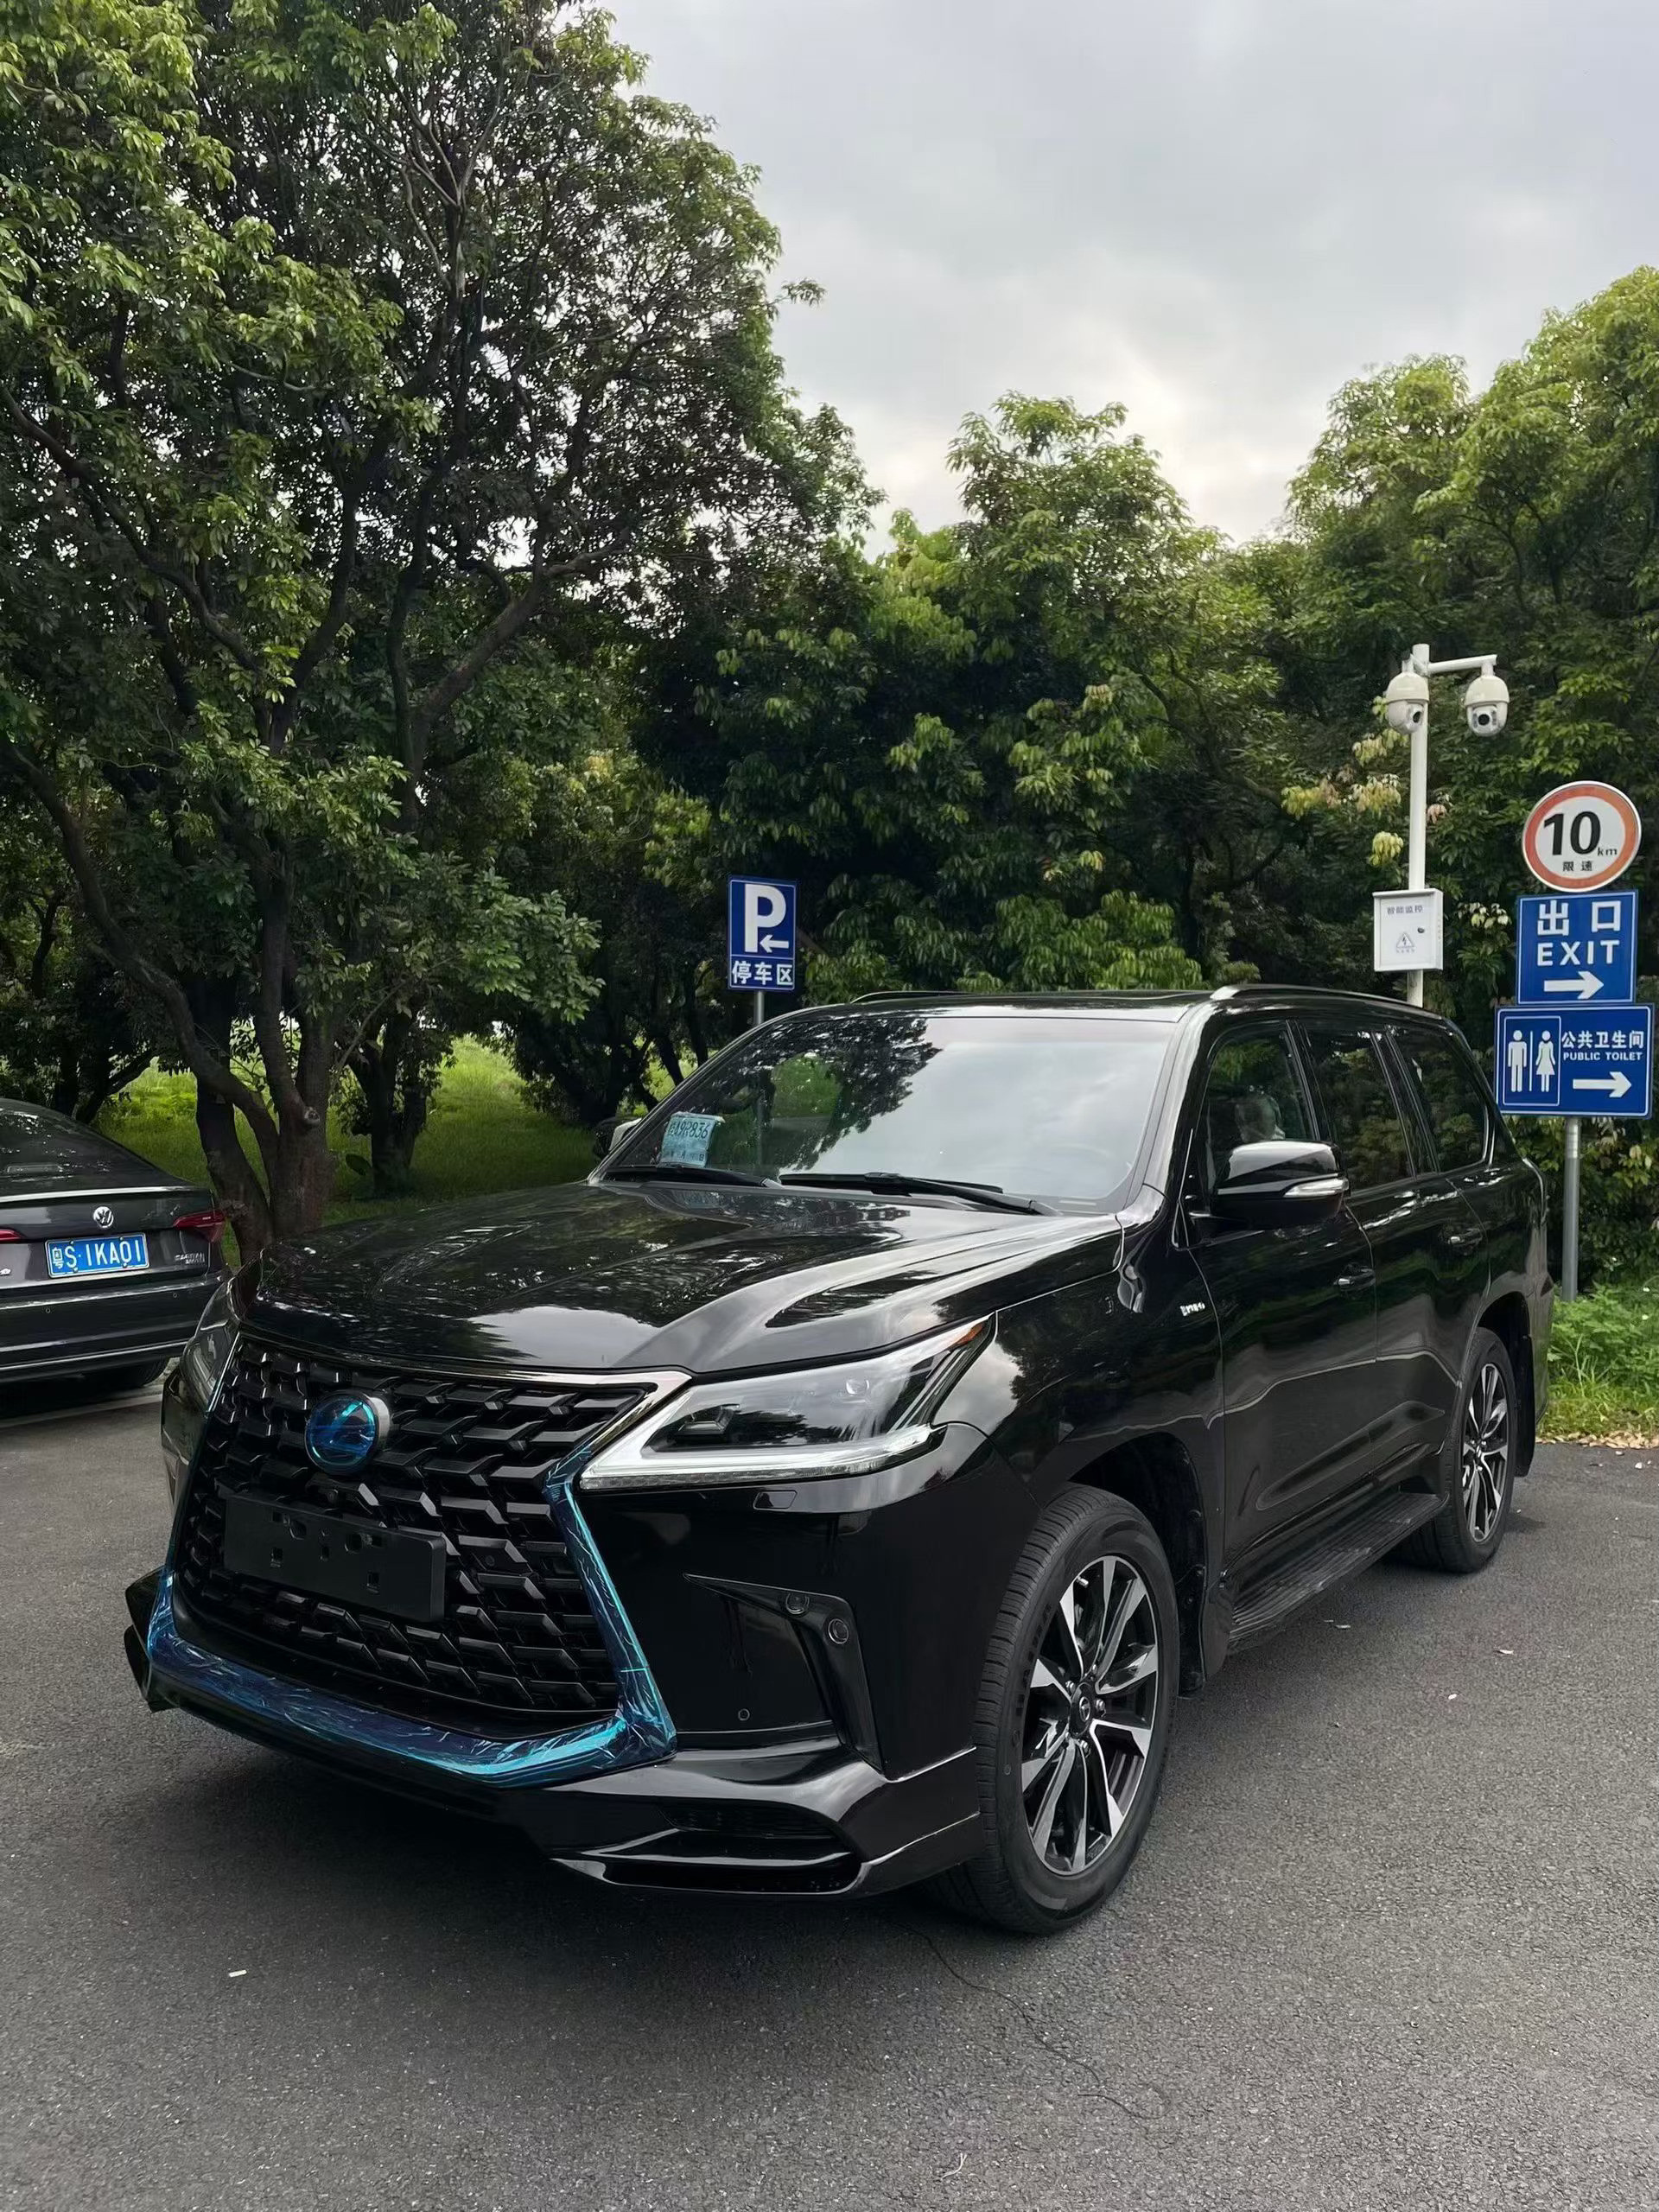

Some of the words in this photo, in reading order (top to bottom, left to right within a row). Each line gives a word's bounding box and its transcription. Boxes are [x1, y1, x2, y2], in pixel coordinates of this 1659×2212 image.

[1544, 810, 1601, 855] 10
[1597, 847, 1618, 856] km
[1562, 860, 1592, 872] 限速
[744, 883, 787, 953] P
[1537, 899, 1621, 936] 出口
[1537, 939, 1620, 966] EXIT
[732, 960, 793, 985] 停车区
[1561, 1030, 1644, 1049] 公共卫生间
[1563, 1052, 1600, 1061] PUBLIC
[1605, 1052, 1643, 1061] TOILET
